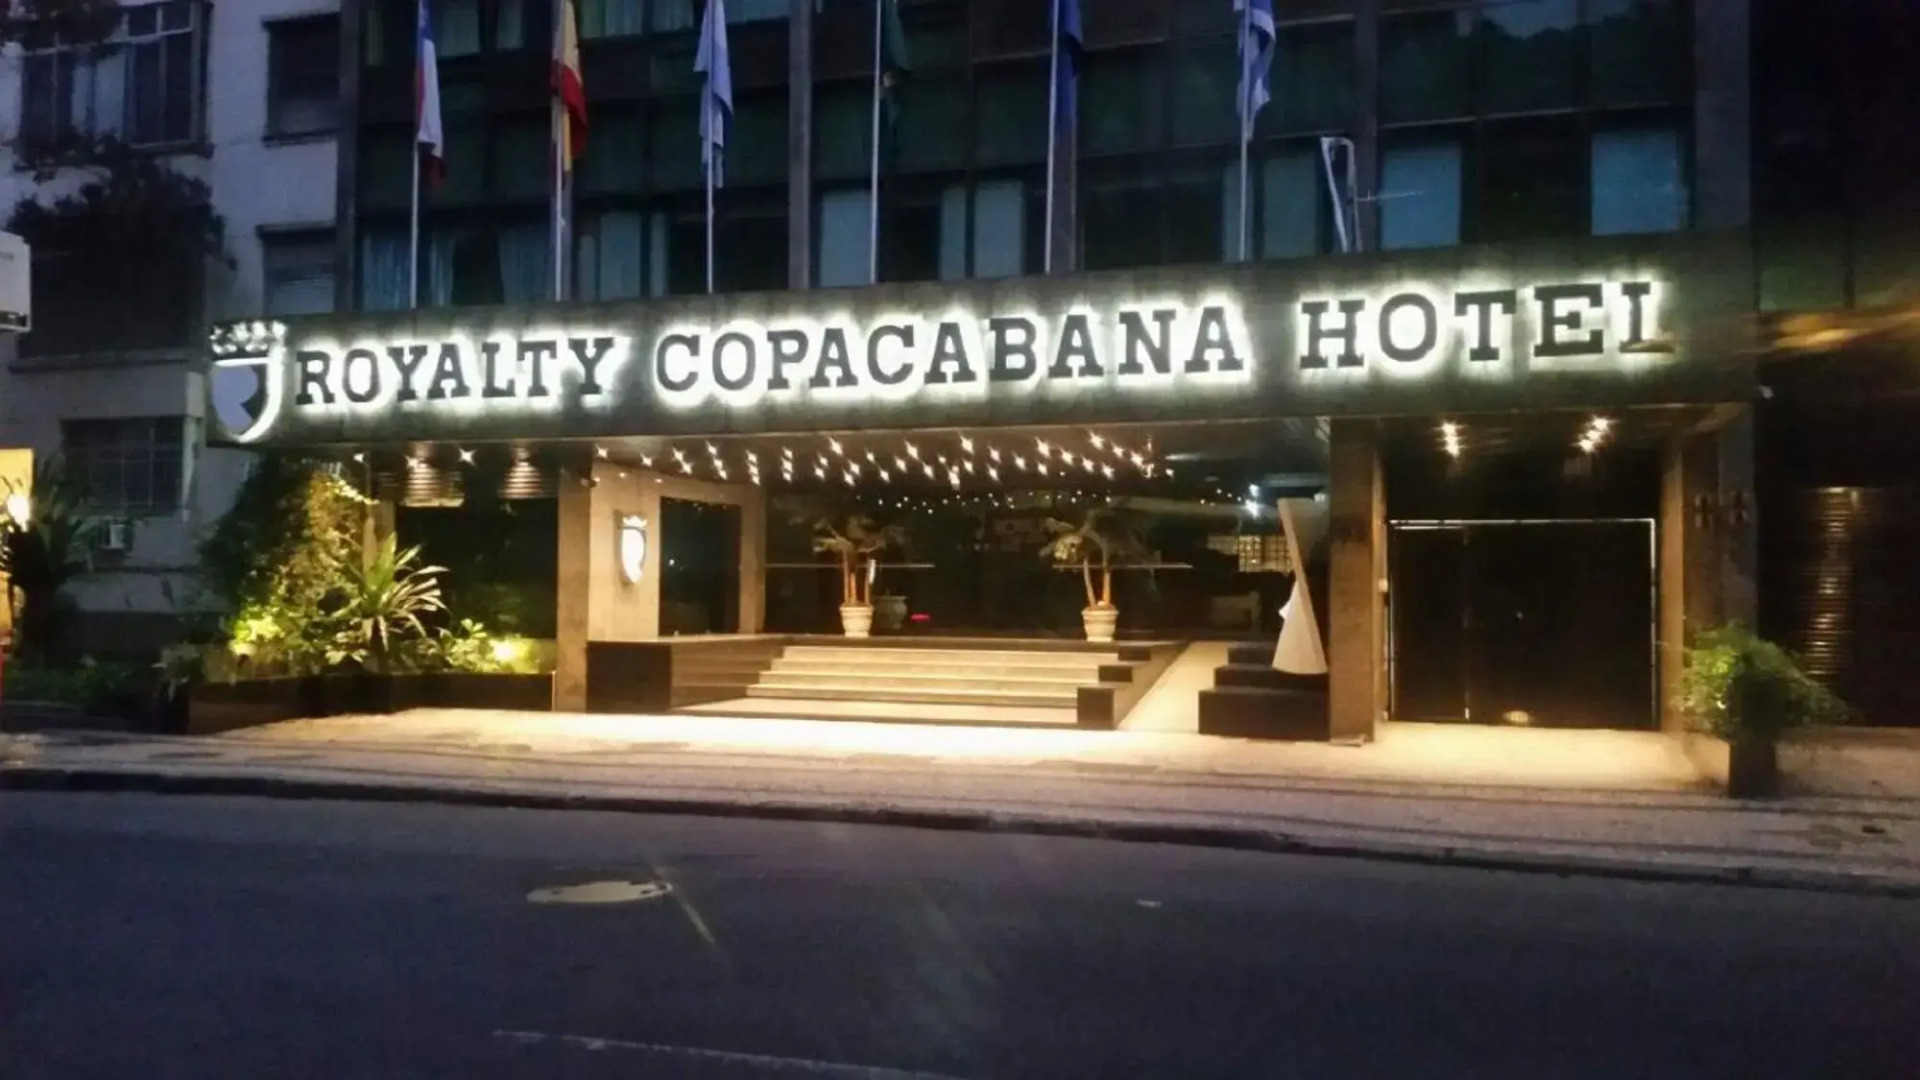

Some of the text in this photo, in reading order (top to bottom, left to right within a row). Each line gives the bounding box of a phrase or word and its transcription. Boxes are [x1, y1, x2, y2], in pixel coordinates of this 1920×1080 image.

[296, 281, 1674, 405] ROYALTY COPACABANA HOTEL
